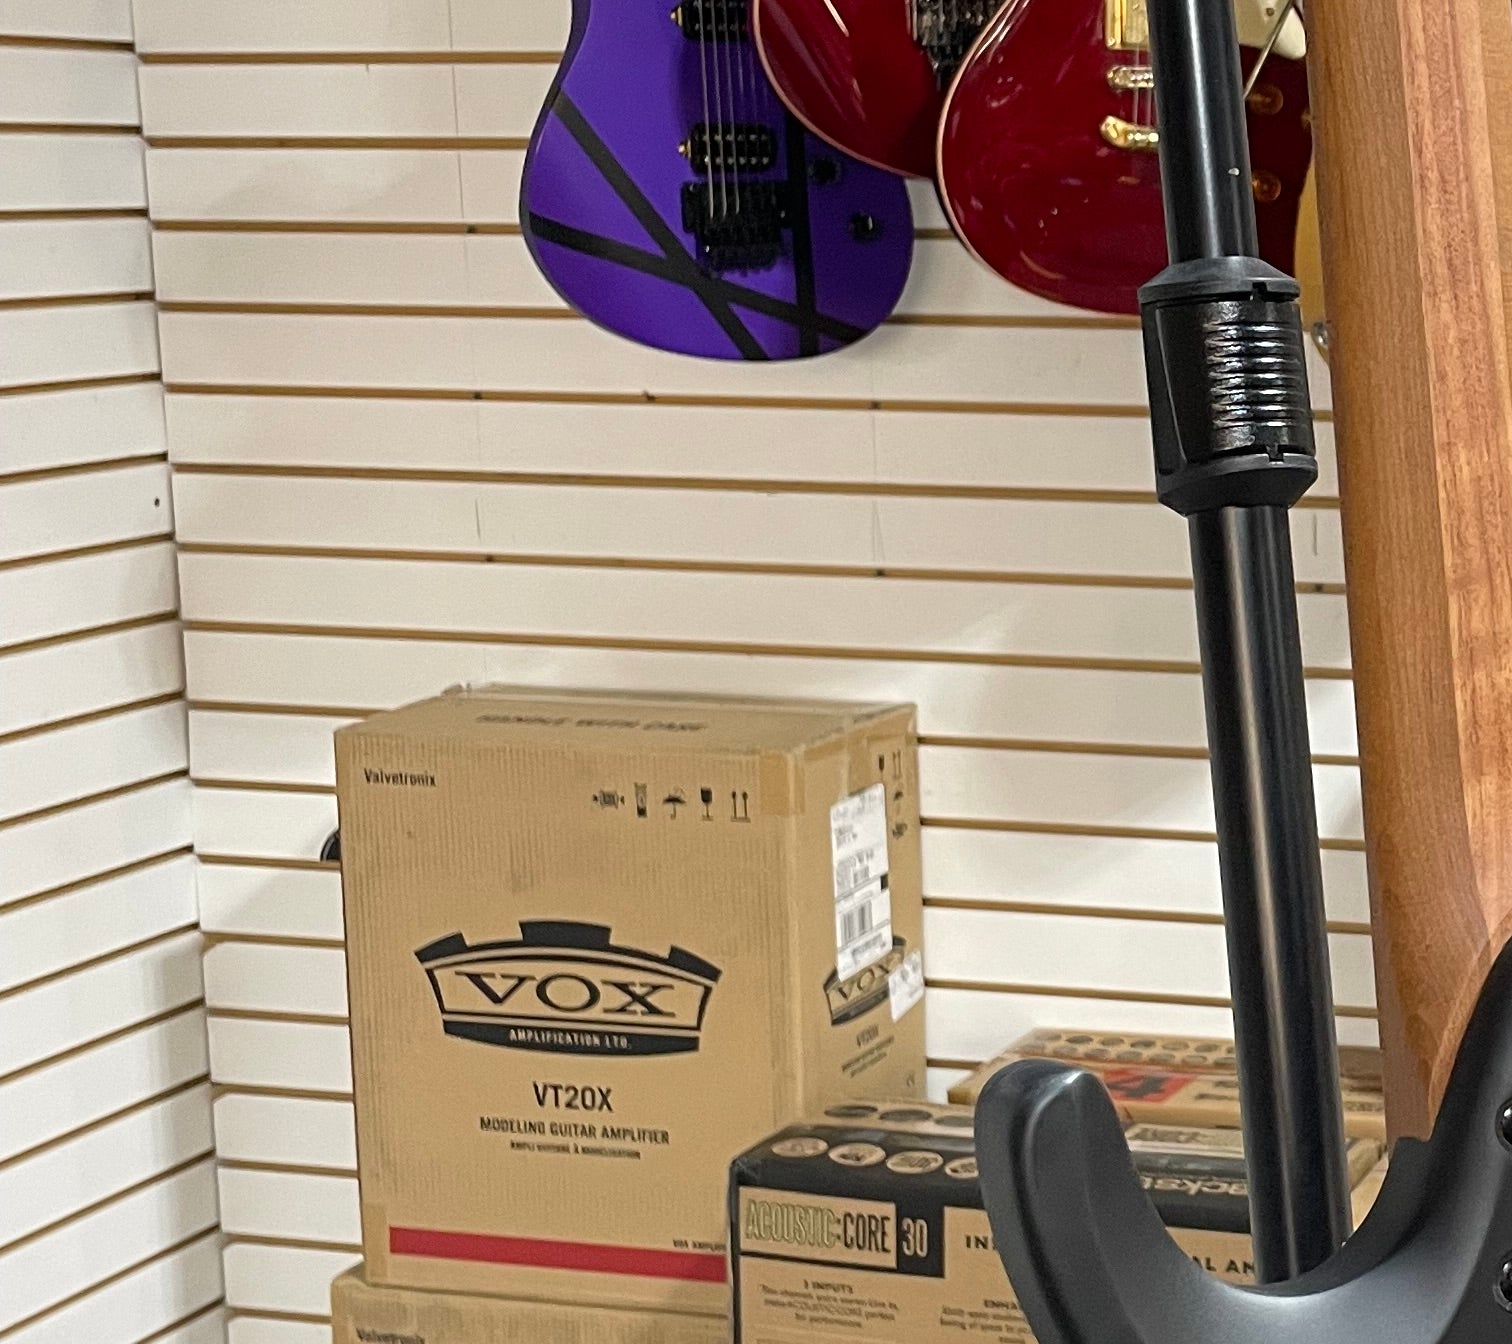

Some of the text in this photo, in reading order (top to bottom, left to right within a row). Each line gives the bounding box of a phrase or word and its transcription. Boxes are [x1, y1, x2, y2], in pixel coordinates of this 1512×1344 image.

[363, 767, 437, 787] Valvetronix
[454, 969, 676, 1018] VOX
[508, 1028, 600, 1049] AMPLIFICATION
[531, 1079, 615, 1113] VT20X
[479, 1115, 670, 1146] MODELING GUITAR AMPLIFIER
[900, 1217, 930, 1258] 30
